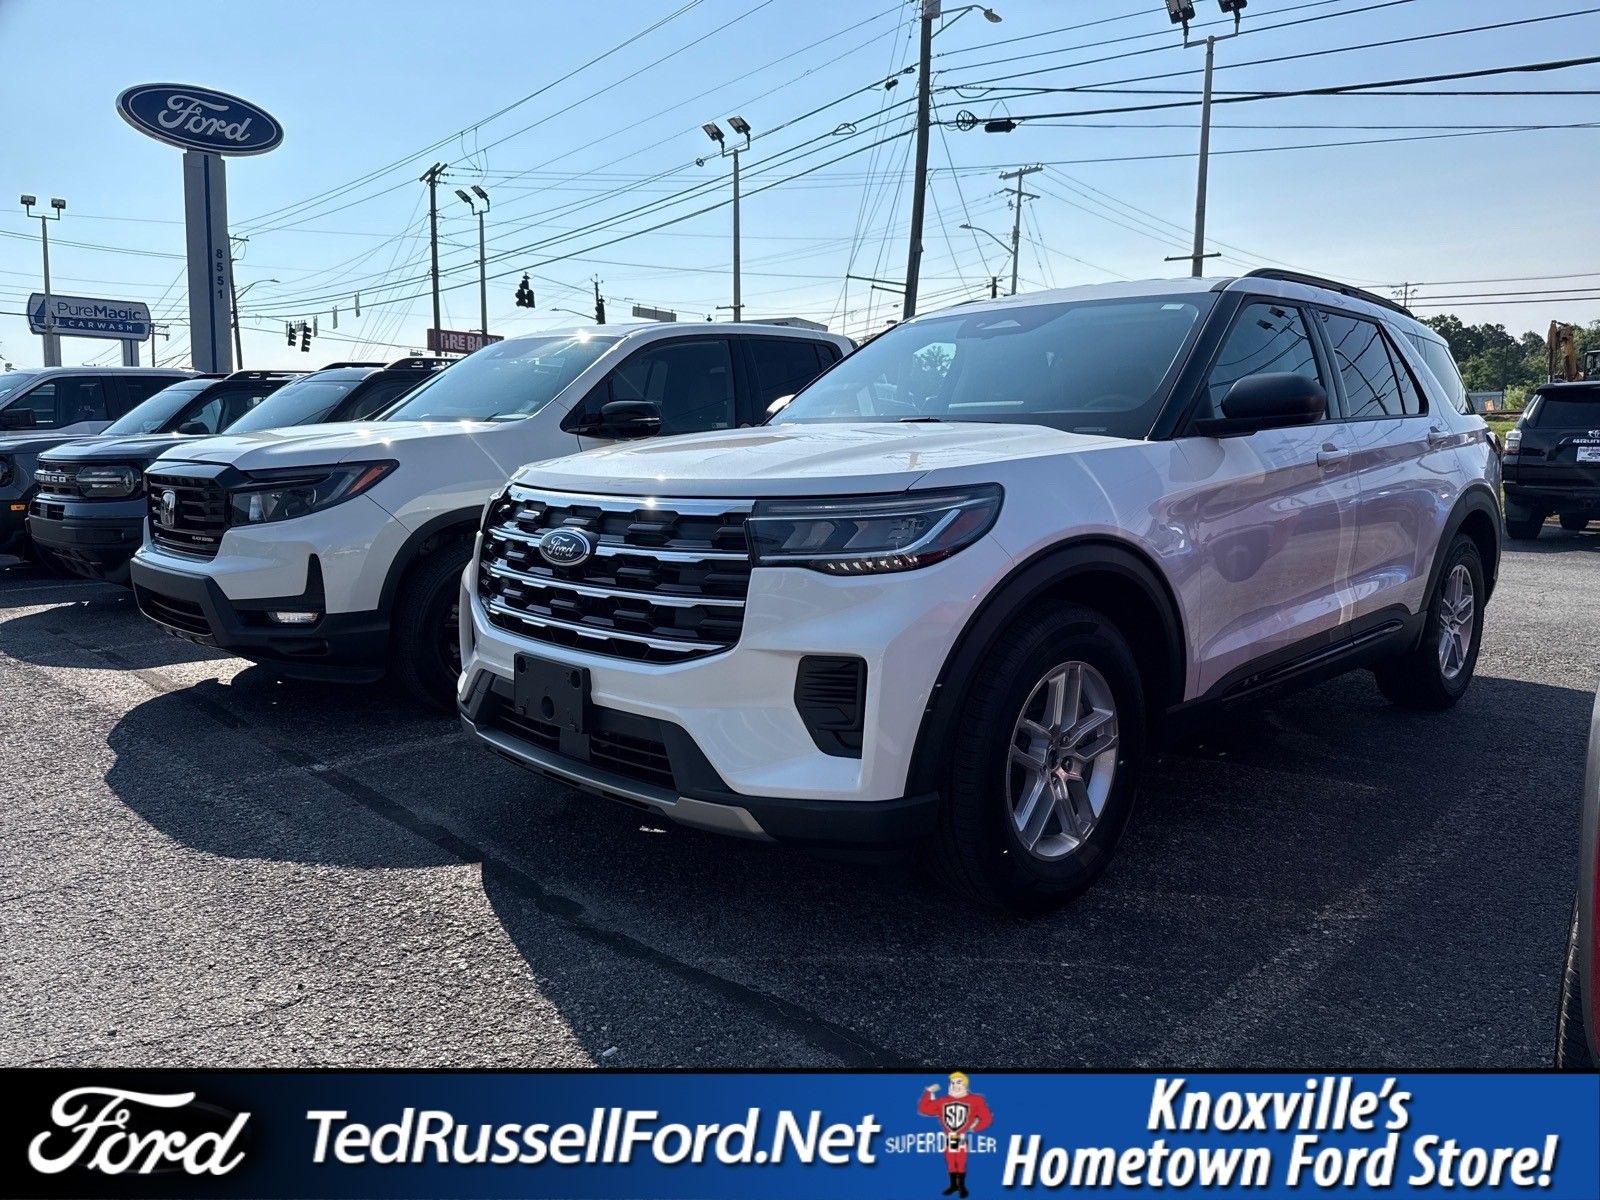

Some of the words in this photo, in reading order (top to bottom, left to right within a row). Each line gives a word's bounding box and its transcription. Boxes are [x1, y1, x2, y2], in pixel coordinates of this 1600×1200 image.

[158, 94, 252, 141] Ford
[216, 248, 224, 299] 8551
[57, 301, 142, 321] PureMagic
[68, 321, 133, 332] CARWASH
[547, 535, 576, 558] Ford
